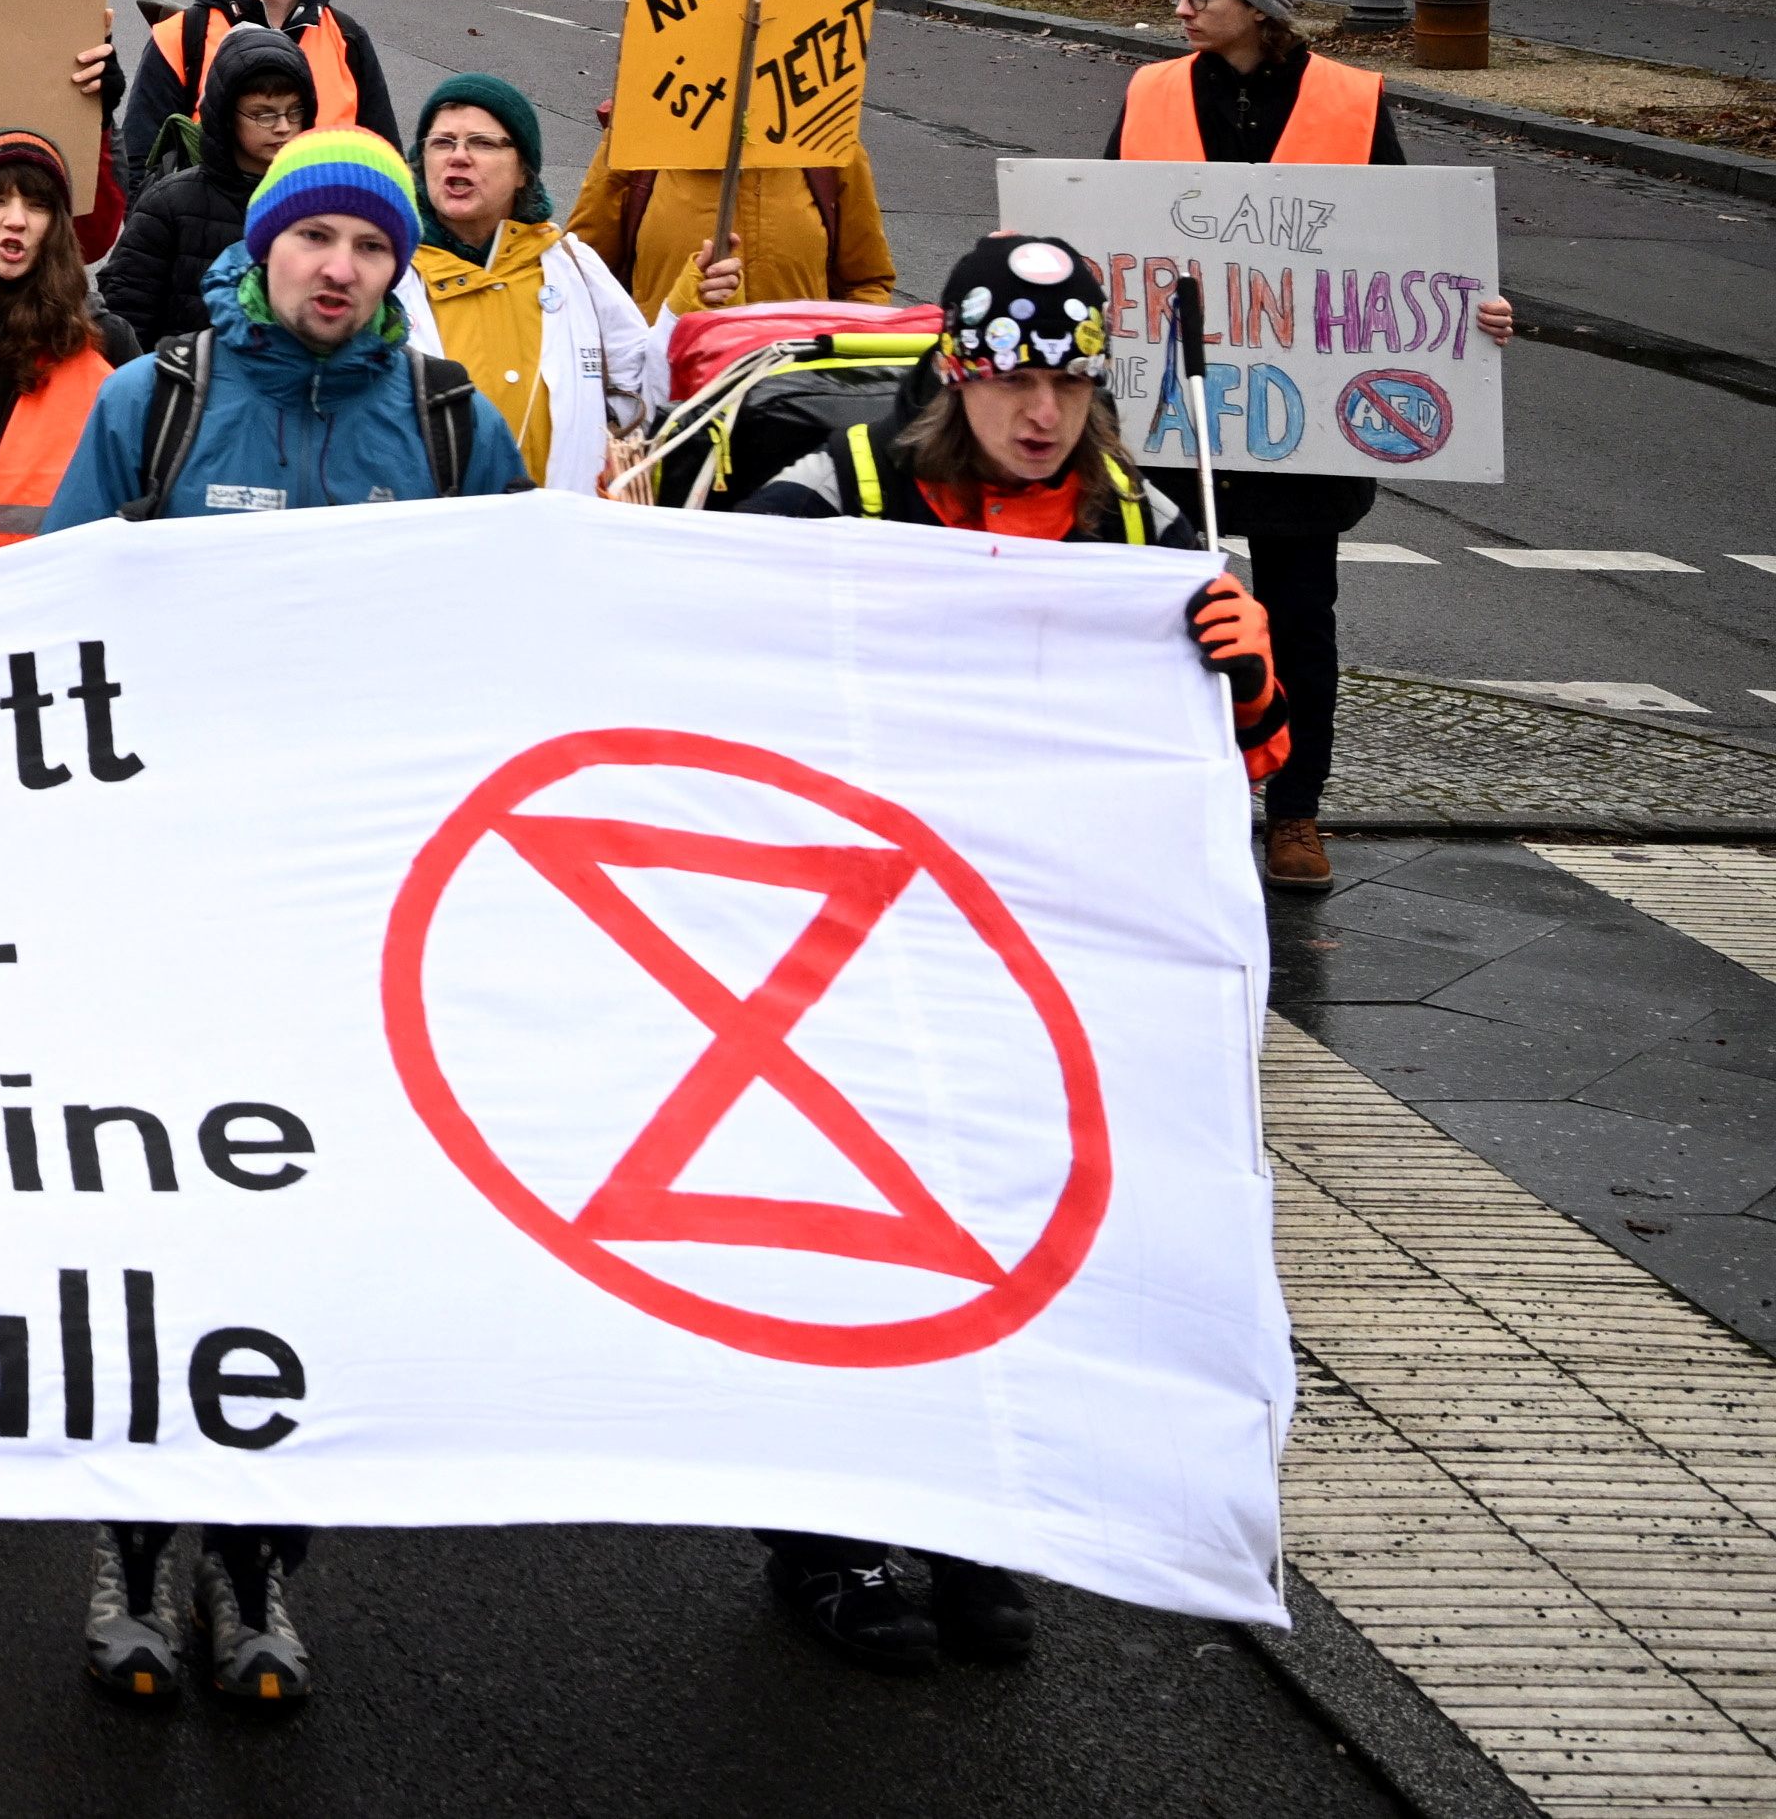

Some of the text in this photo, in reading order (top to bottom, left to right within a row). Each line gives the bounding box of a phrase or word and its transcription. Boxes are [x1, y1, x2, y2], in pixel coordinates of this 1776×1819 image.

[652, 54, 727, 131] ist
[1171, 190, 1336, 254] GANZ
[1314, 268, 1482, 360] HASST
[1107, 355, 1148, 400] IE
[1143, 362, 1306, 462] AFD
